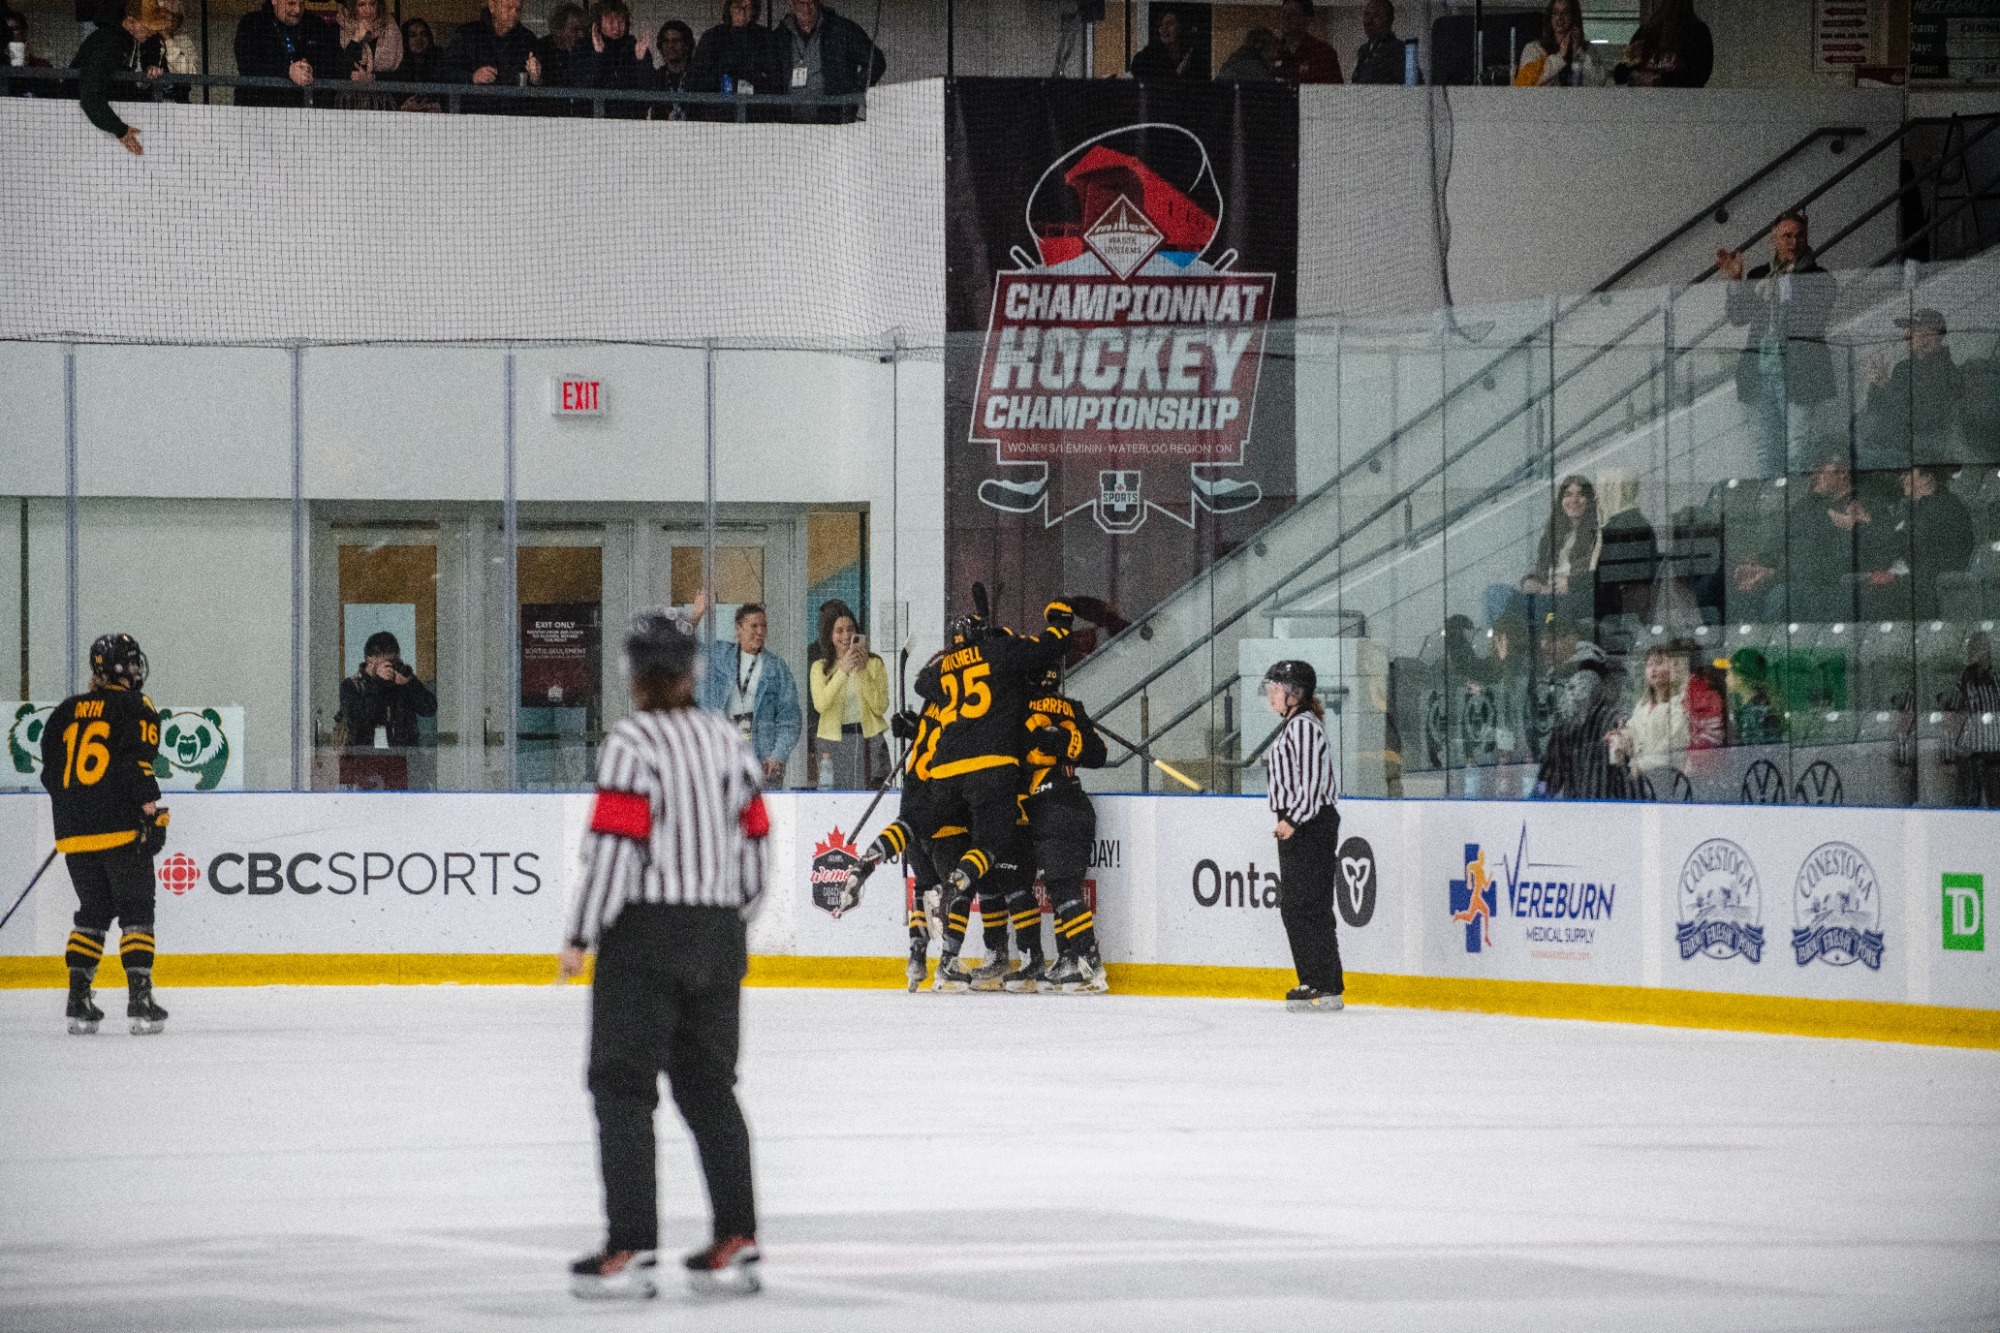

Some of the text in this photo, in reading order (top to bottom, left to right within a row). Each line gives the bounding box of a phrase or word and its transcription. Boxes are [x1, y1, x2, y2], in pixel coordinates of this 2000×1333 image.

[1004, 283, 1264, 322] CHAMPIONNAT
[990, 324, 1252, 391] HOCKEY
[563, 381, 600, 410] EXIT
[983, 395, 1240, 430] CHAMPIONSHIP
[1108, 443, 1168, 454] WATERLOO
[1215, 443, 1233, 454] ON
[1103, 493, 1138, 503] SPORTS
[535, 621, 576, 629] EXIT ONLY
[139, 719, 159, 746] 16
[63, 720, 111, 789] 16
[1192, 858, 1281, 909] Onta
[1502, 820, 1616, 920] VEREBURN
[1683, 845, 1754, 896] CONESTOGA
[1800, 848, 1873, 901] CONESTOGA
[1945, 887, 1980, 936] TD
[1526, 926, 1596, 944] MEDICAL SUPPLY
